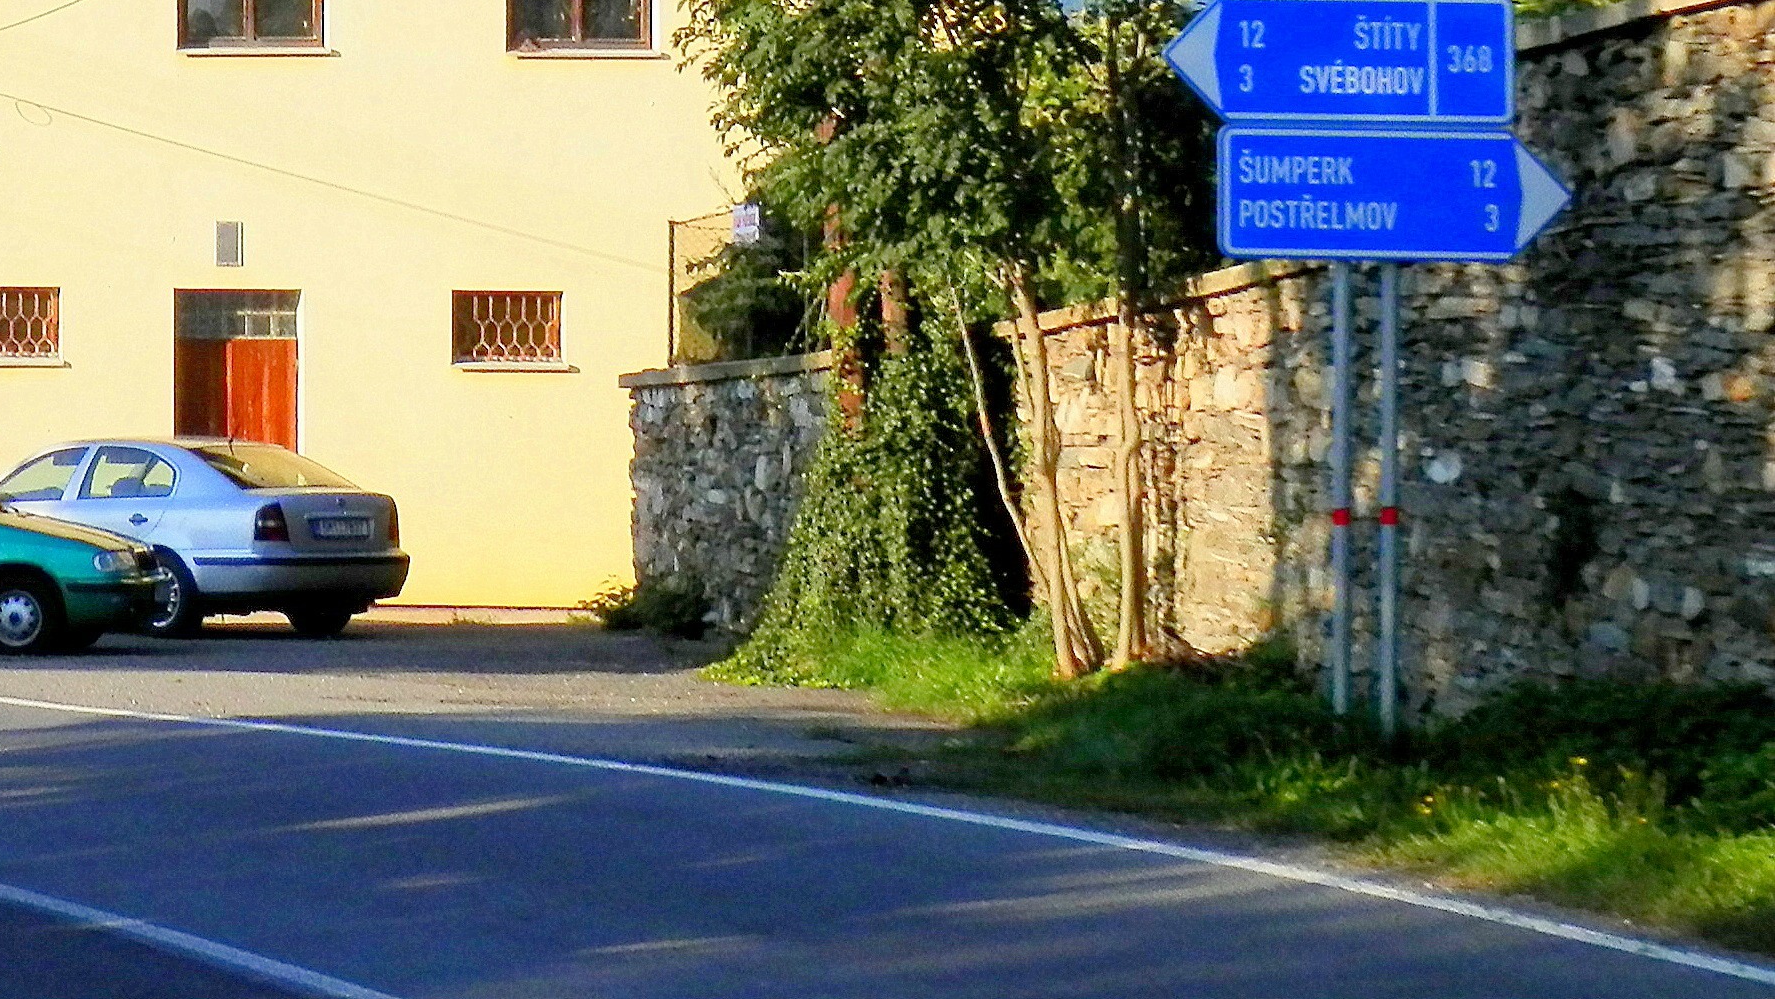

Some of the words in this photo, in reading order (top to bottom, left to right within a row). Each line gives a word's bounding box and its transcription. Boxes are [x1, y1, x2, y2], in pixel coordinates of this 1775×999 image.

[1238, 20, 1266, 49] 12
[1353, 14, 1422, 51] ŠTÍTY
[1238, 64, 1254, 92] 3
[1299, 59, 1425, 95] SVÉBOHOV
[1446, 45, 1493, 73] 368
[1238, 148, 1354, 185] ŠUMPERK
[1471, 160, 1497, 188] 12
[1238, 194, 1397, 231] POSTŘELMOV
[1484, 204, 1500, 232] 3
